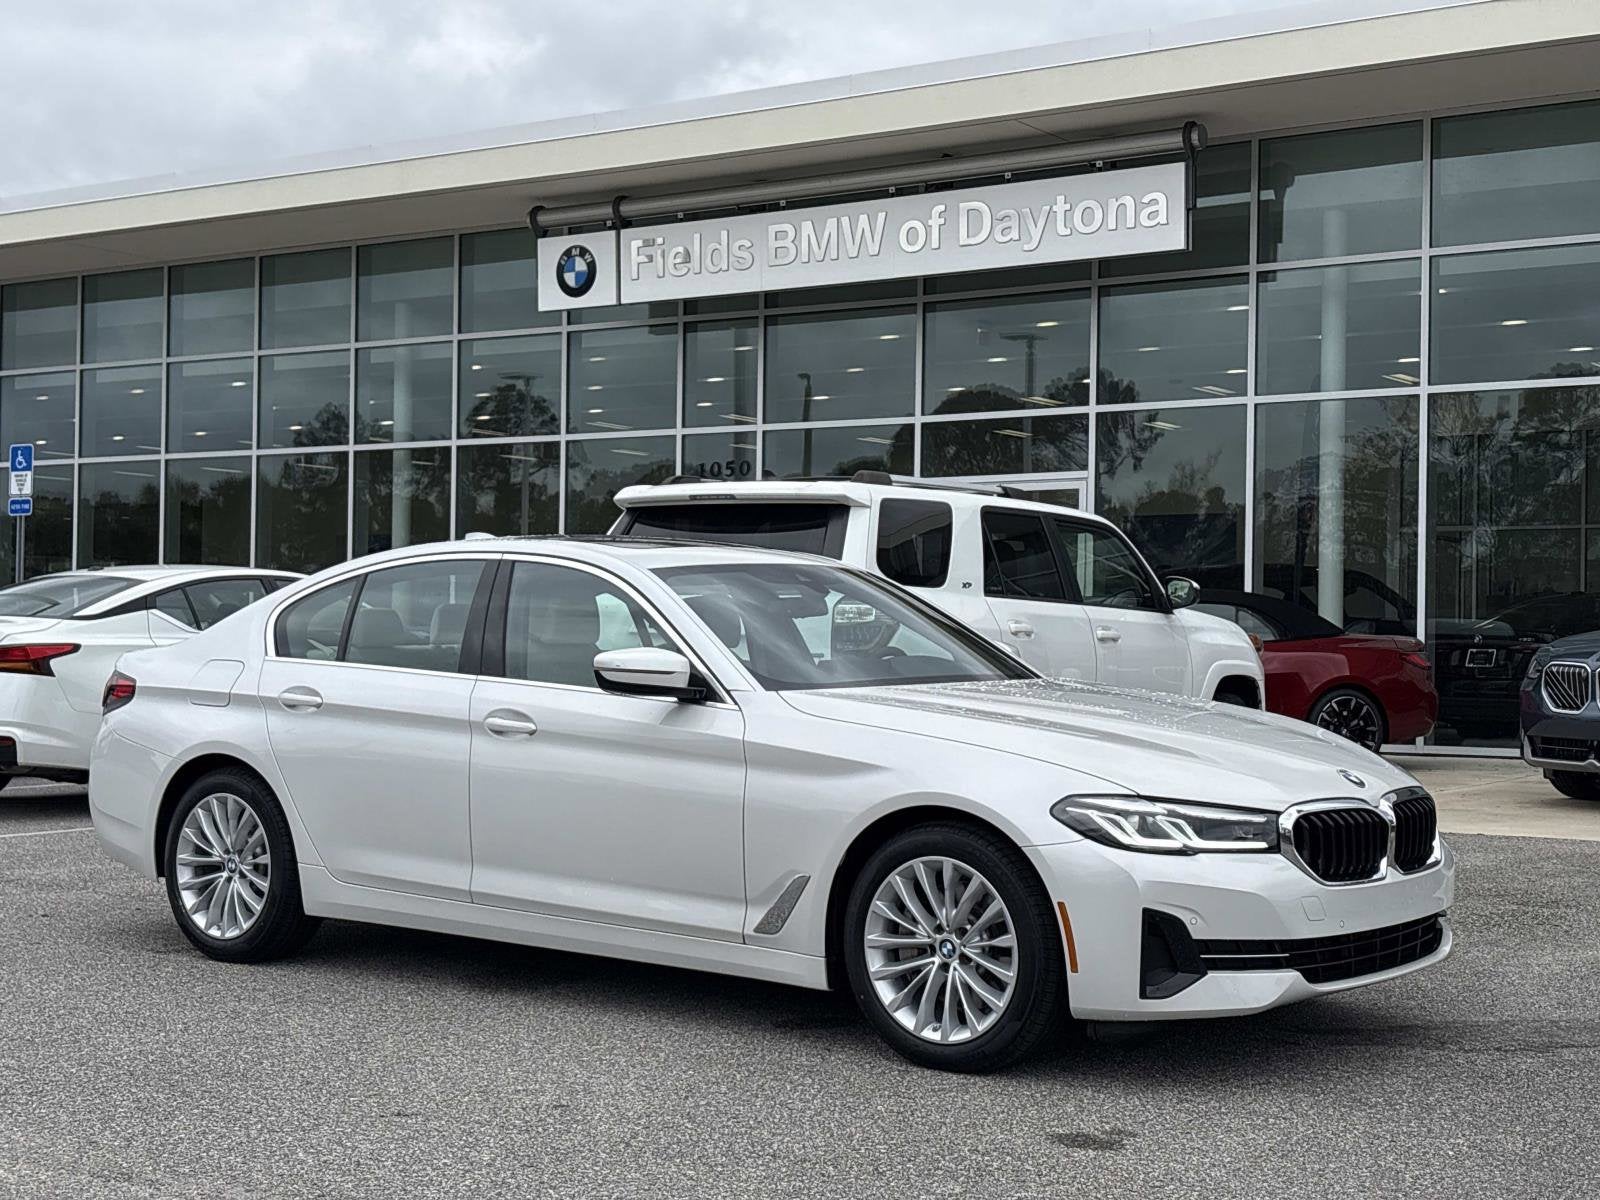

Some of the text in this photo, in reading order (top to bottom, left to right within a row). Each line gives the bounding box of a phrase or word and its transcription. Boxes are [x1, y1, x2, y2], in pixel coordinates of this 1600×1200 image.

[630, 191, 1169, 281] Fields BMW of Daytona
[560, 248, 593, 265] BMW
[698, 460, 751, 477] 1050
